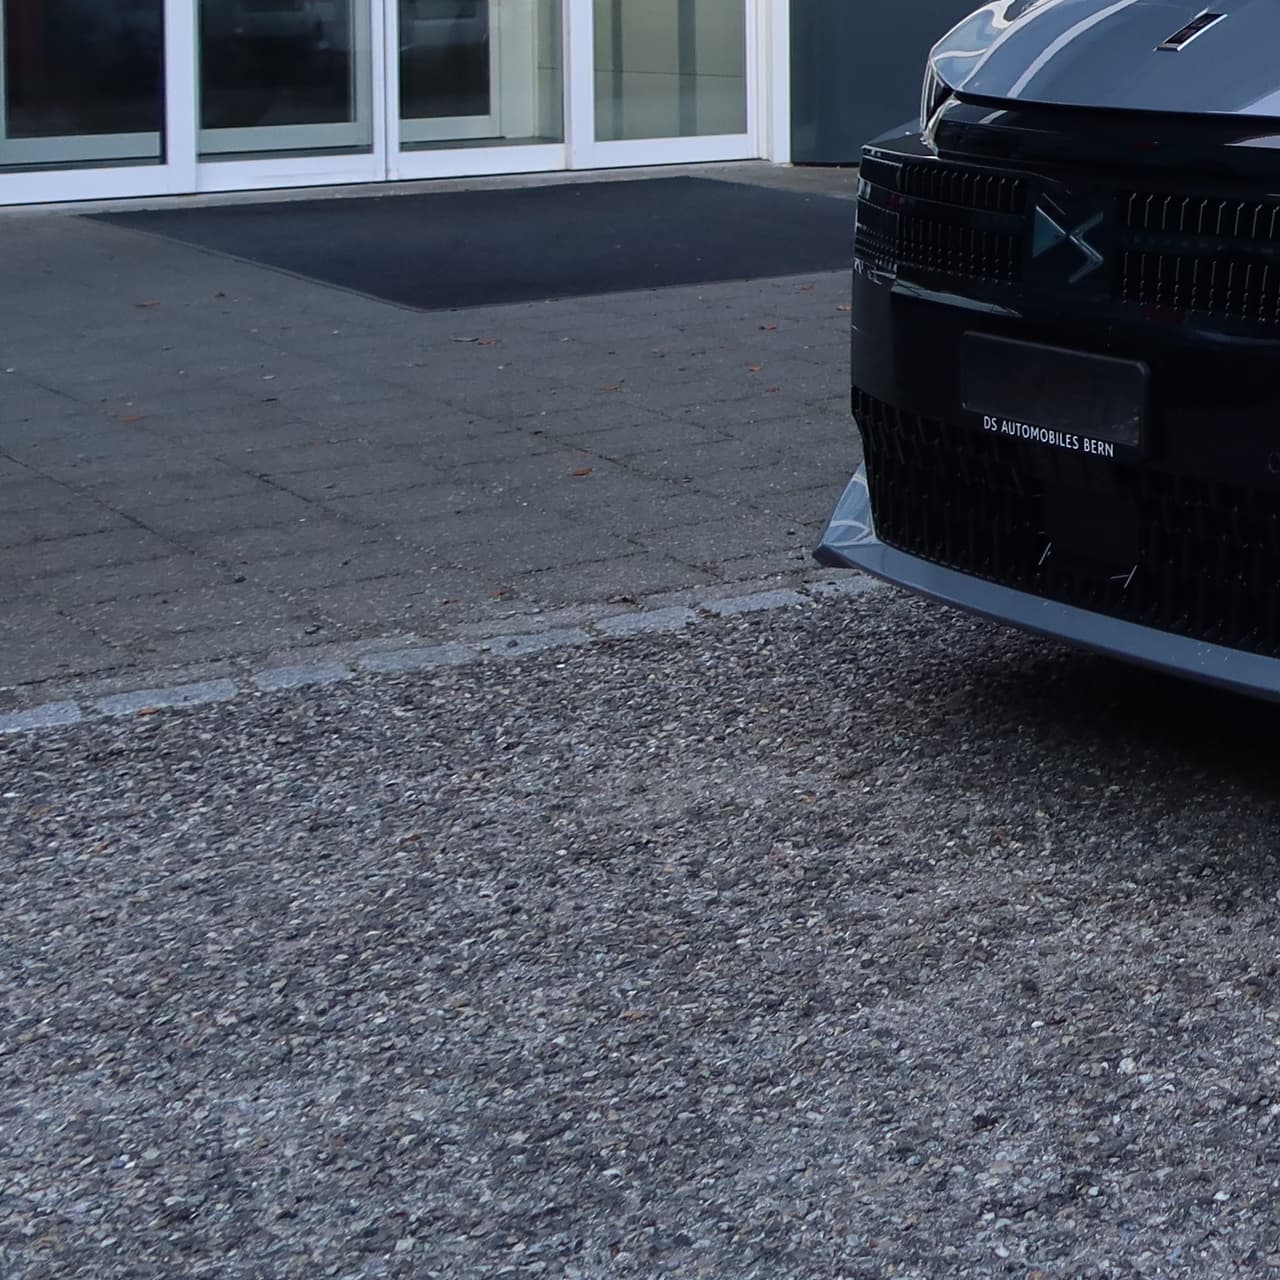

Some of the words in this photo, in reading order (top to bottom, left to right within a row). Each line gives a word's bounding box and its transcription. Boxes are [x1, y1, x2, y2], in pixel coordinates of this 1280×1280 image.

[983, 415, 998, 431] DS
[1000, 419, 1080, 450] AUTOMOBILES
[1083, 437, 1114, 457] BERN
